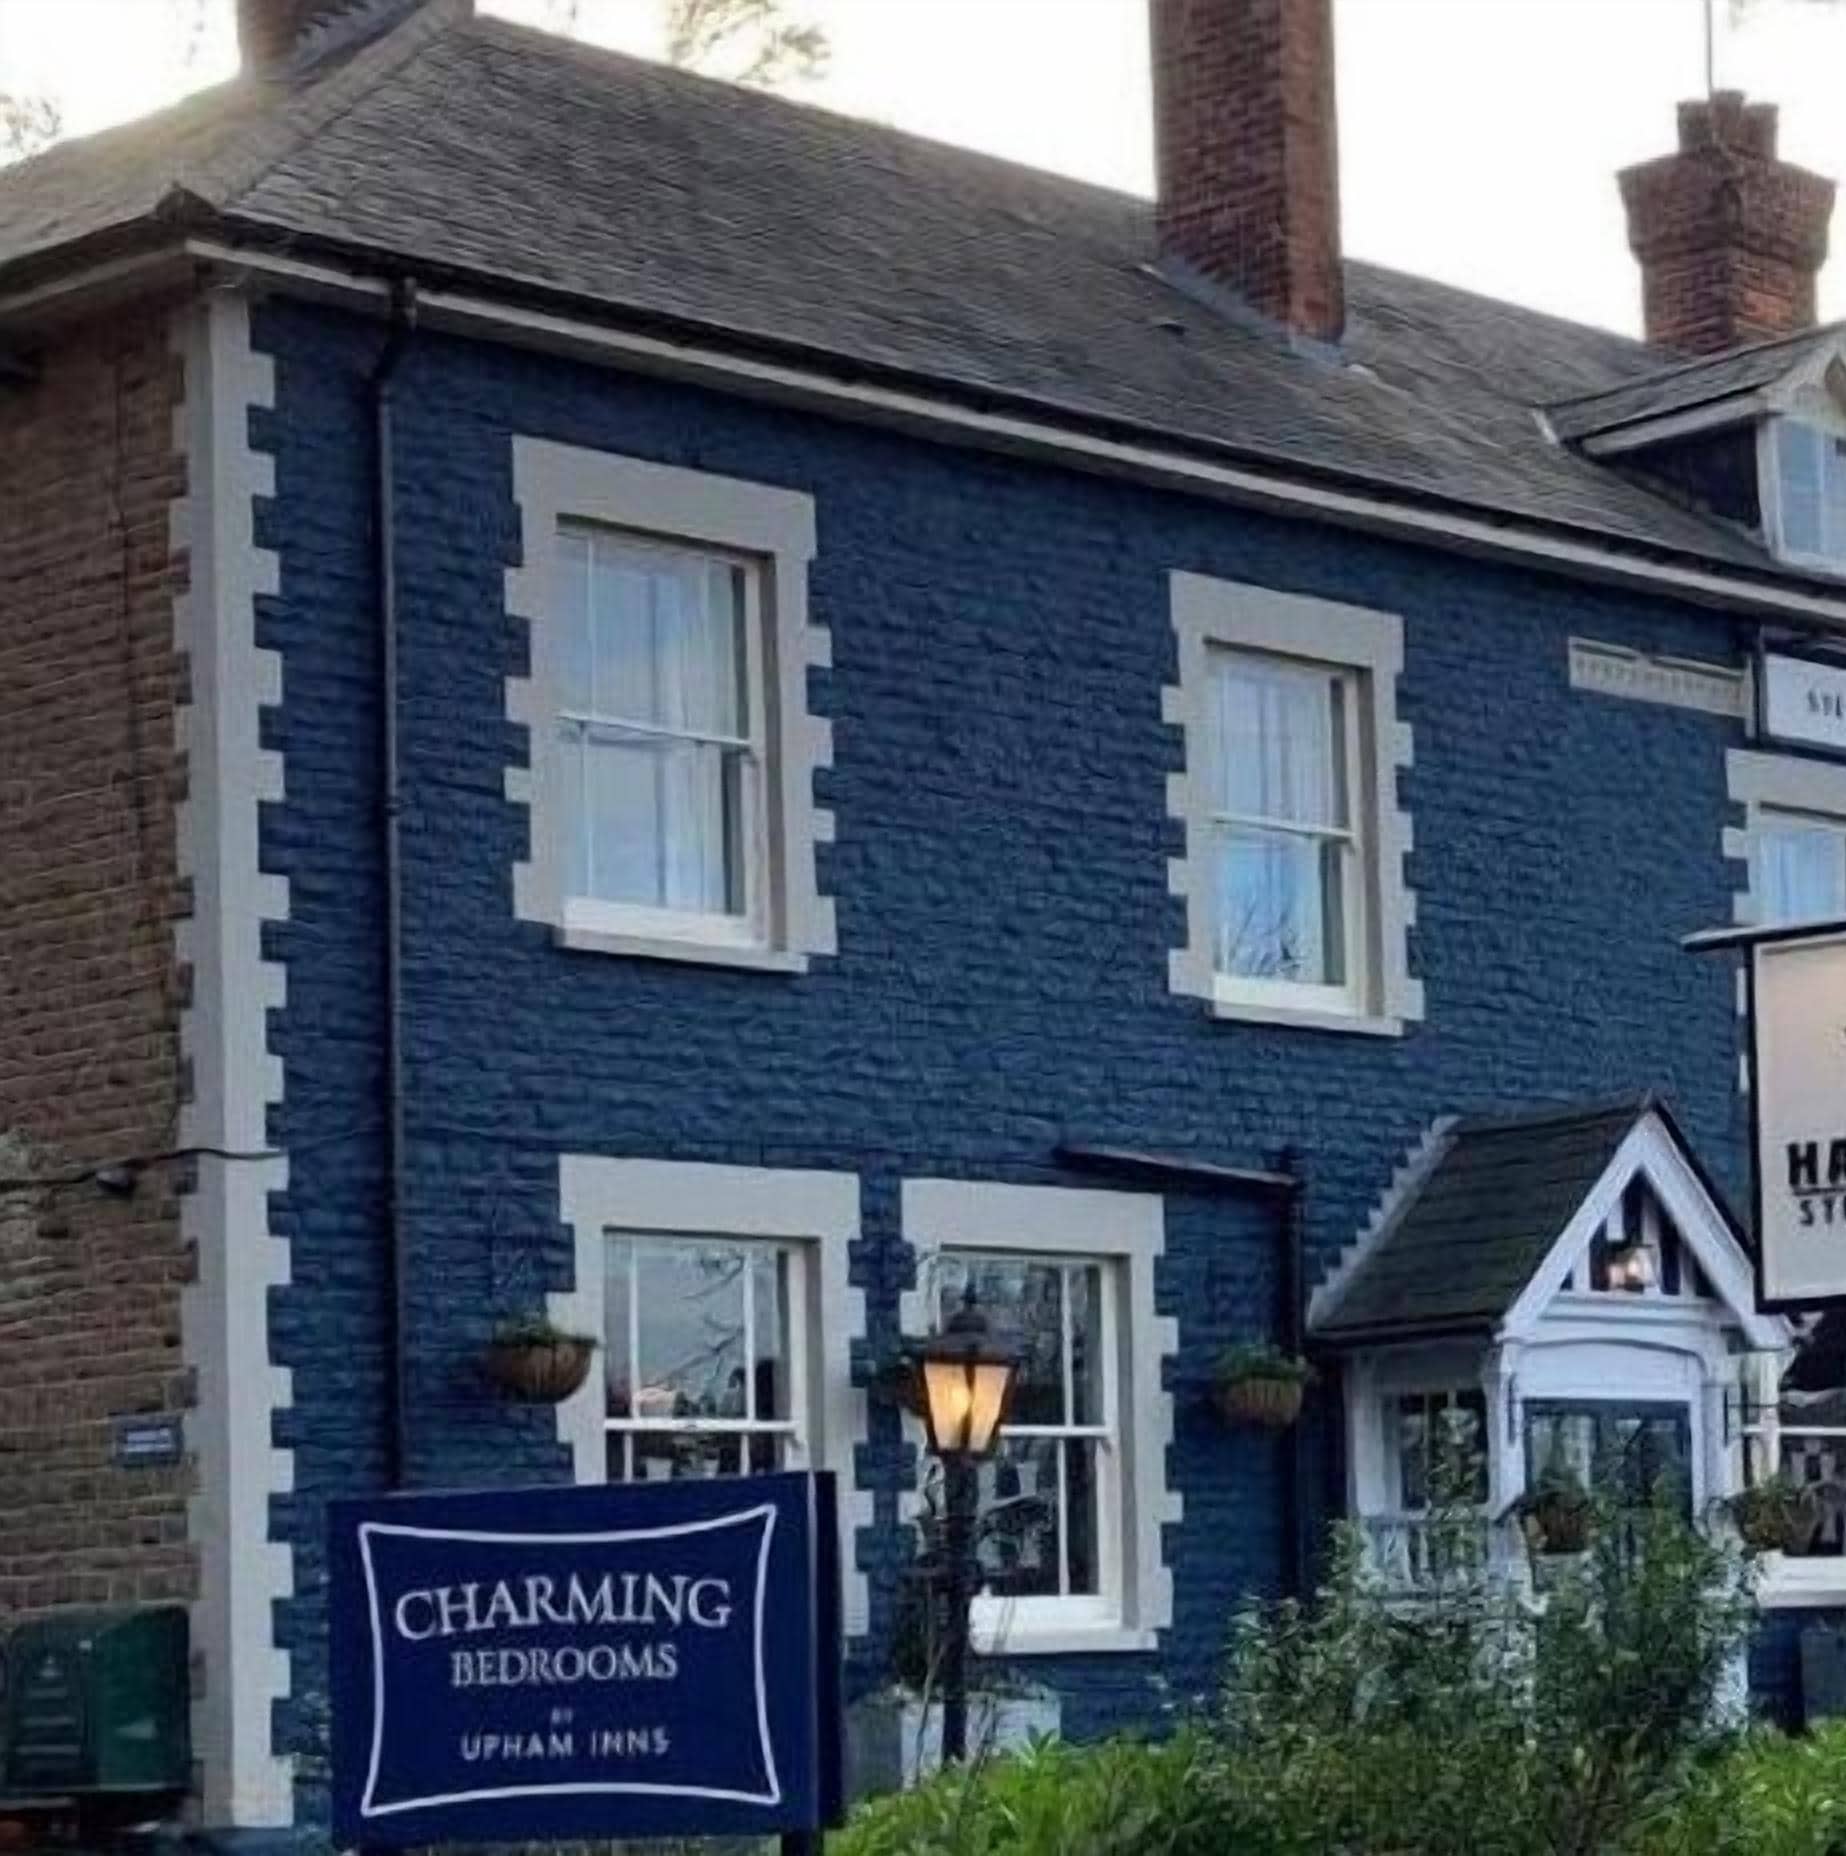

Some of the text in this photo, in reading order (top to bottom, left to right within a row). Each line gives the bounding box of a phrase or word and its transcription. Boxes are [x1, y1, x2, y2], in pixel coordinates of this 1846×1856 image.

[396, 1572, 733, 1640] CHARMING
[451, 1644, 678, 1687] BEDROOMS
[460, 1726, 671, 1761] UPHAM INNS
